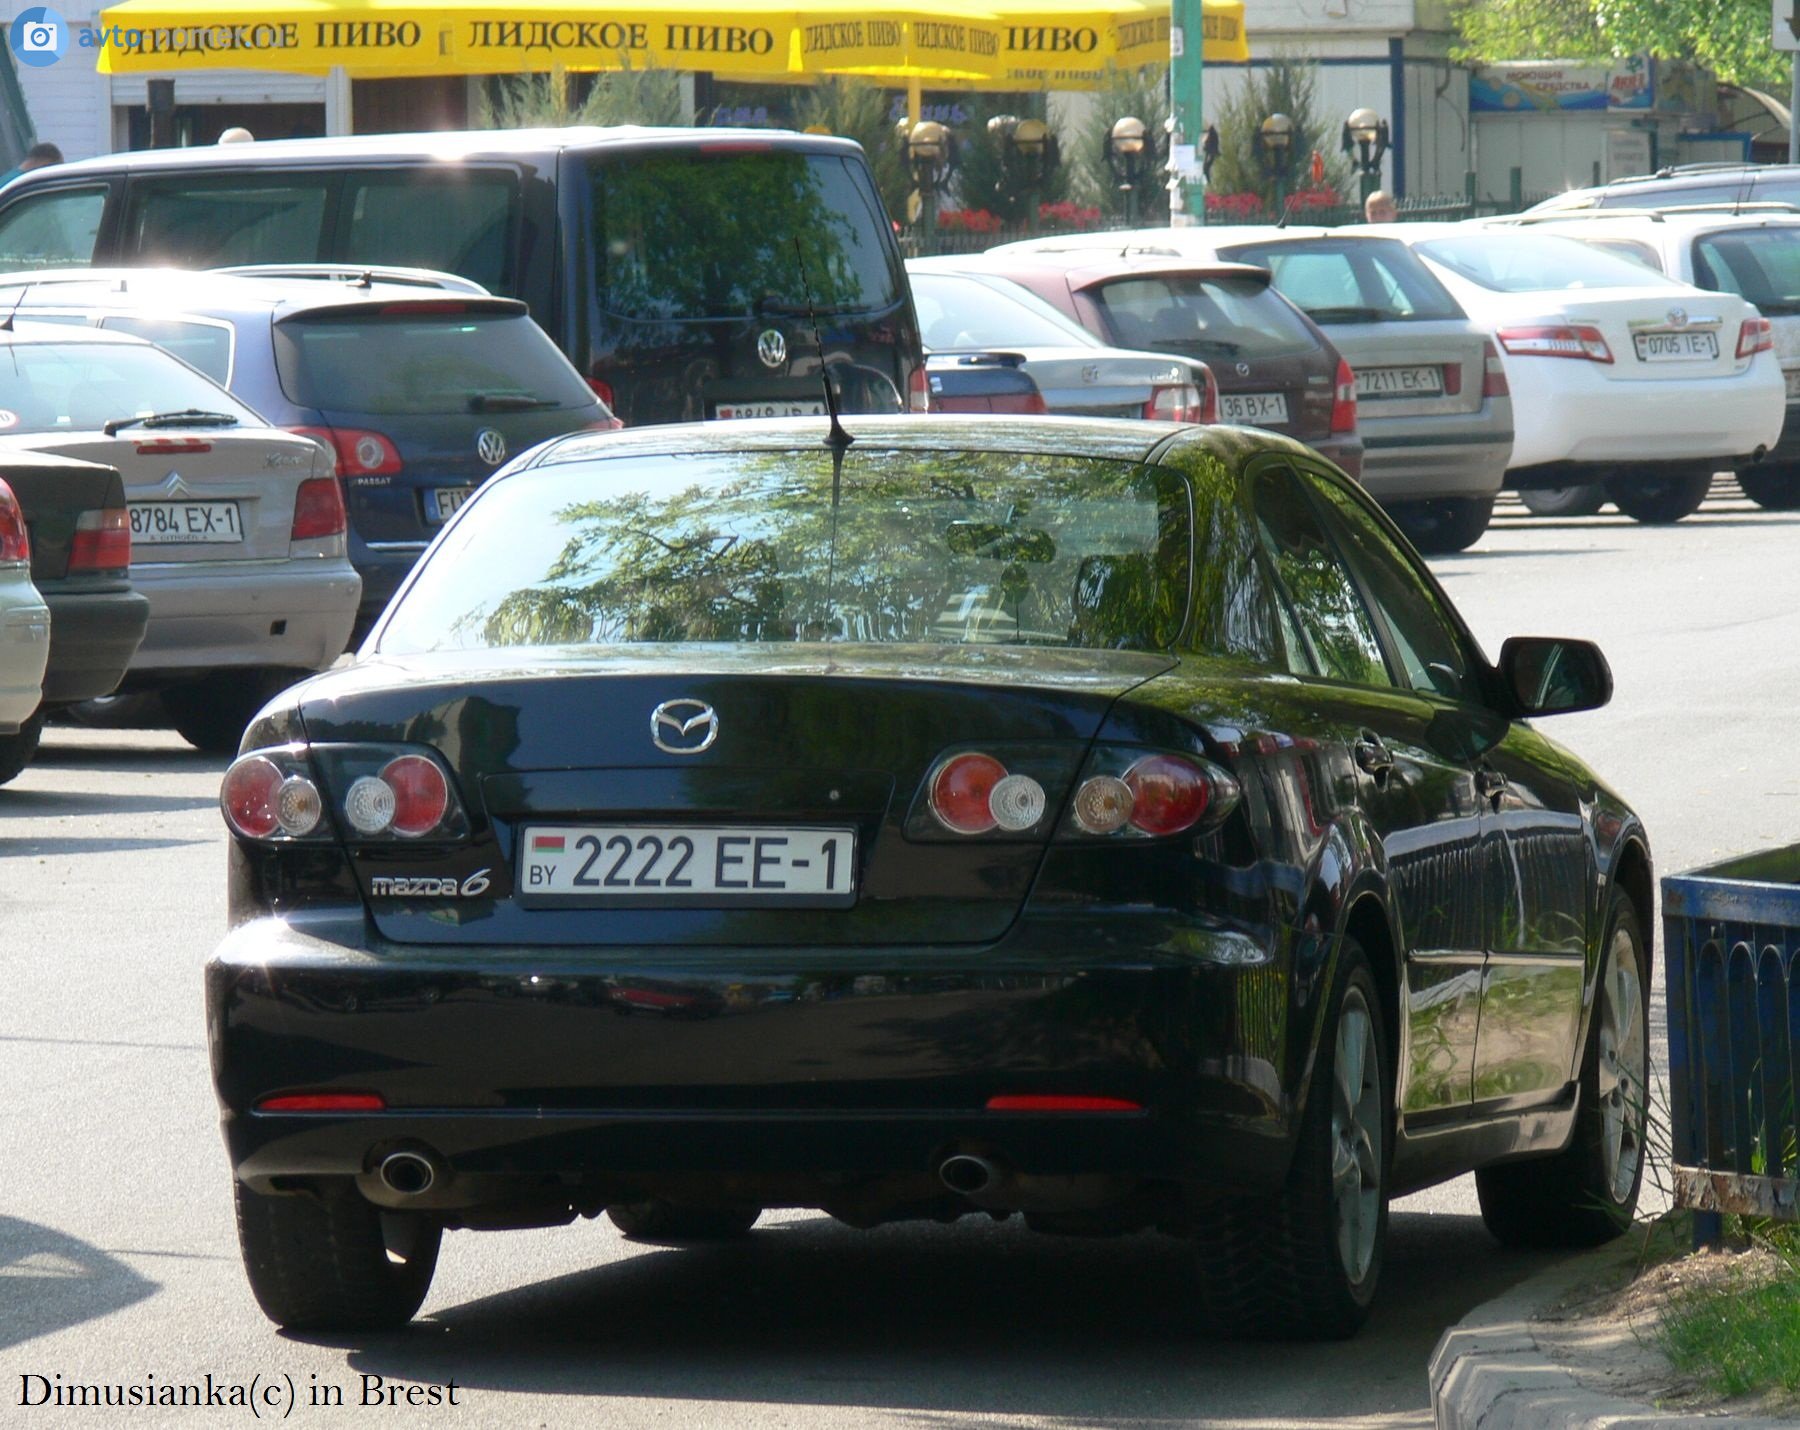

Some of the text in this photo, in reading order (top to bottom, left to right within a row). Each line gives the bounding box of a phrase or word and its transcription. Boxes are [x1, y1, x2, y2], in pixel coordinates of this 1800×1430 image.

[121, 22, 300, 57] ЛИДСКОЕ
[314, 20, 421, 48] ПИВО
[468, 20, 649, 52] ЛИДСКОЕ
[664, 23, 774, 55] ПИВО
[804, 20, 901, 53] ЛИДСКОЕ ПИВО
[1648, 336, 1680, 354] 0705
[1361, 371, 1397, 391] 7211
[130, 507, 235, 533] 8784 EX-1
[529, 835, 838, 890] BY 2222 EE-1
